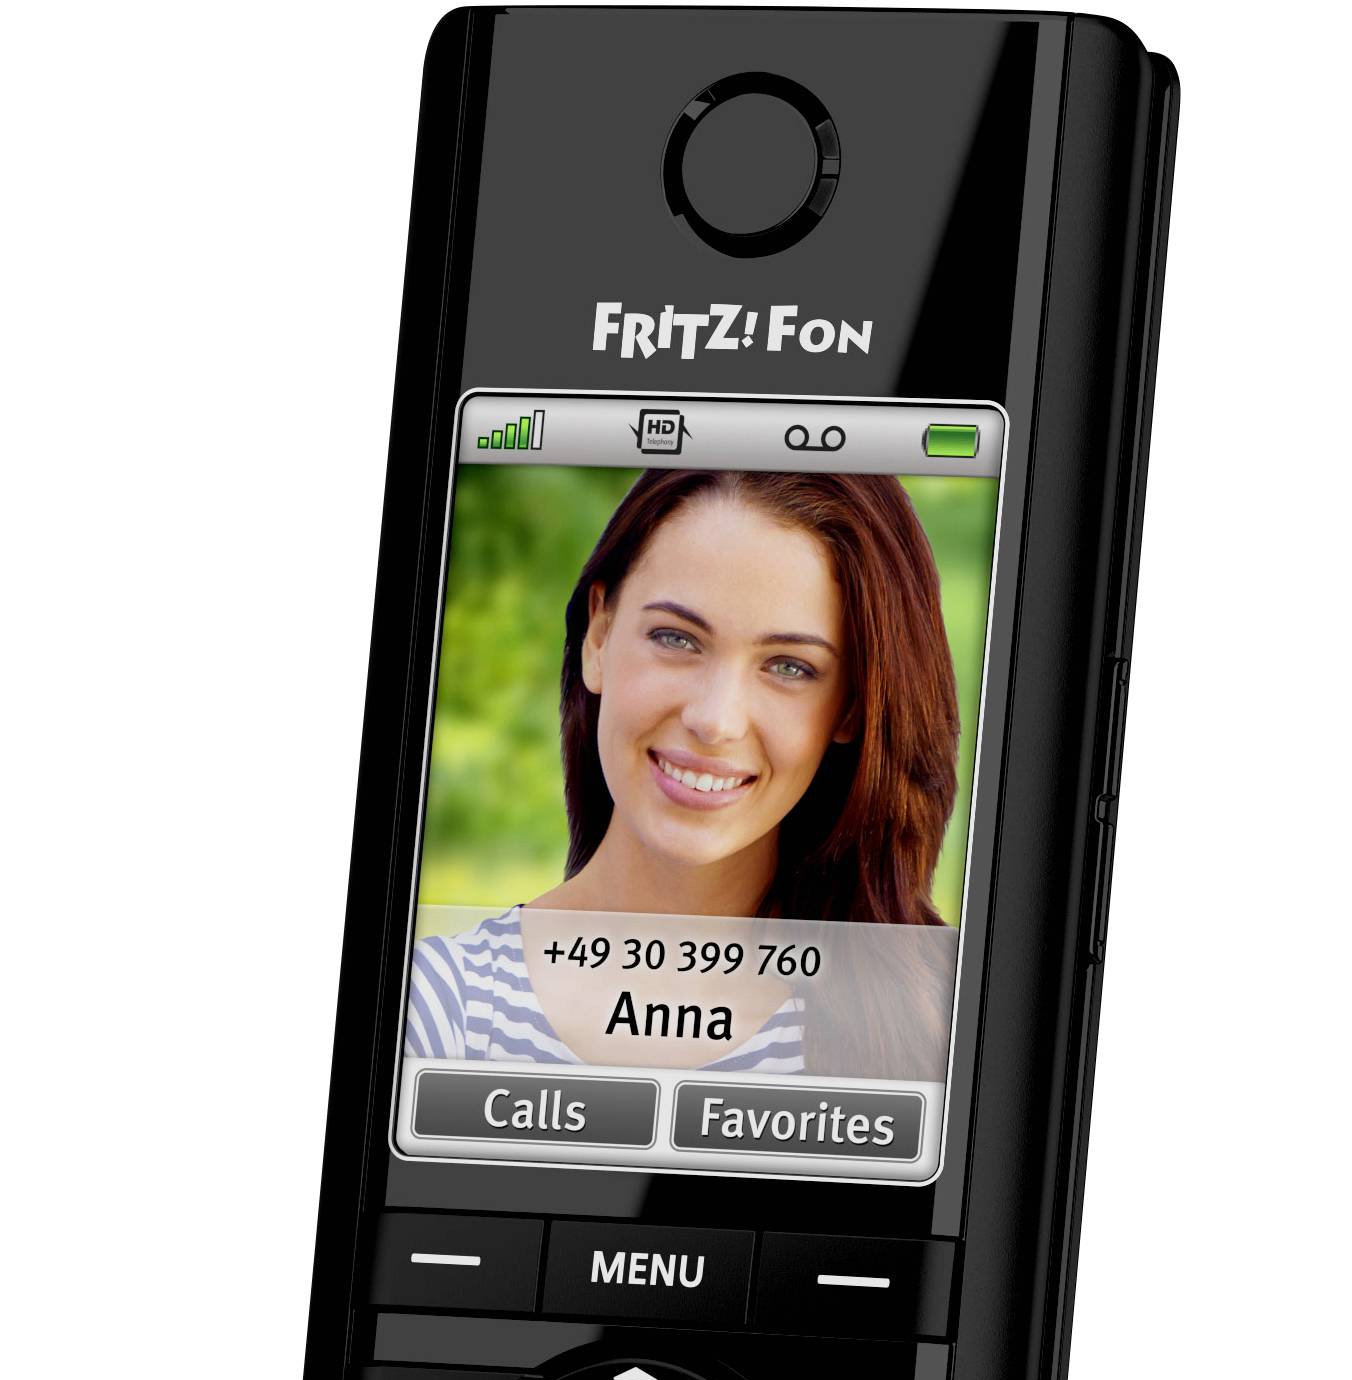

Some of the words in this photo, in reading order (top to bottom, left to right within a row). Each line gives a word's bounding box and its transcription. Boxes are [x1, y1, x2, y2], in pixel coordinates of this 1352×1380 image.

[592, 301, 759, 360] FRITZ!
[766, 304, 874, 355] FON
[647, 419, 676, 435] HD
[543, 936, 611, 969] +49
[621, 938, 666, 970] 30
[677, 940, 744, 975] 399
[757, 944, 821, 977] 760
[605, 991, 733, 1041] Anna
[483, 1088, 587, 1133] Calls
[700, 1097, 896, 1147] Favorites
[590, 1250, 705, 1288] MENU
